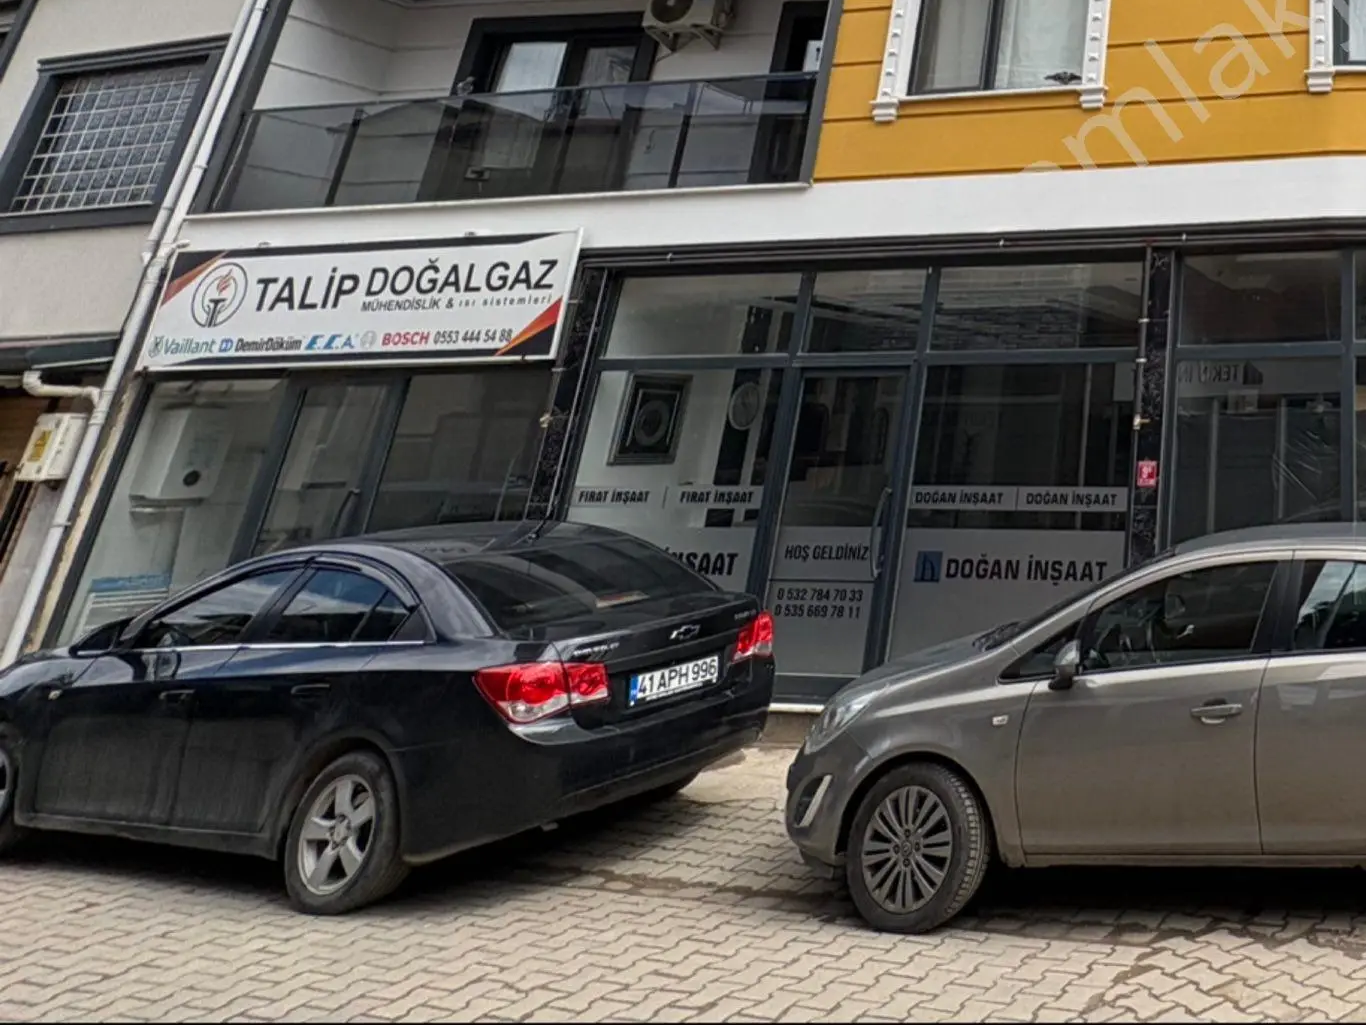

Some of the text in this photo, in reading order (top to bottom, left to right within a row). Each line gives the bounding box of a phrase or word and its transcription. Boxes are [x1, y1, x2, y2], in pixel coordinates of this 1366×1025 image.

[255, 257, 558, 312] TALİP DOĞALGAZ
[361, 297, 441, 312] MÜHENDİSLİK
[445, 300, 454, 309] &
[235, 336, 302, 352] DemirDöküm
[382, 331, 430, 346] BOSCH
[433, 330, 460, 344] 0553
[462, 329, 481, 343] 444
[483, 329, 497, 342] 54
[164, 337, 216, 354] Vaillant
[578, 488, 651, 505] FIRAT İNŞAAT
[679, 488, 755, 505] FIRAT İNŞAAT
[959, 489, 1004, 506] İNŞAAT
[1071, 490, 1118, 508] İNŞAAT
[784, 542, 870, 562] HOŞ GELDİNİZ
[945, 553, 1108, 586] DOĞAN İNŞAAT
[776, 587, 864, 603] 0 532 784 70 33
[774, 604, 861, 619] 0 535 669 78 11
[638, 657, 717, 694] 41 APH 996
